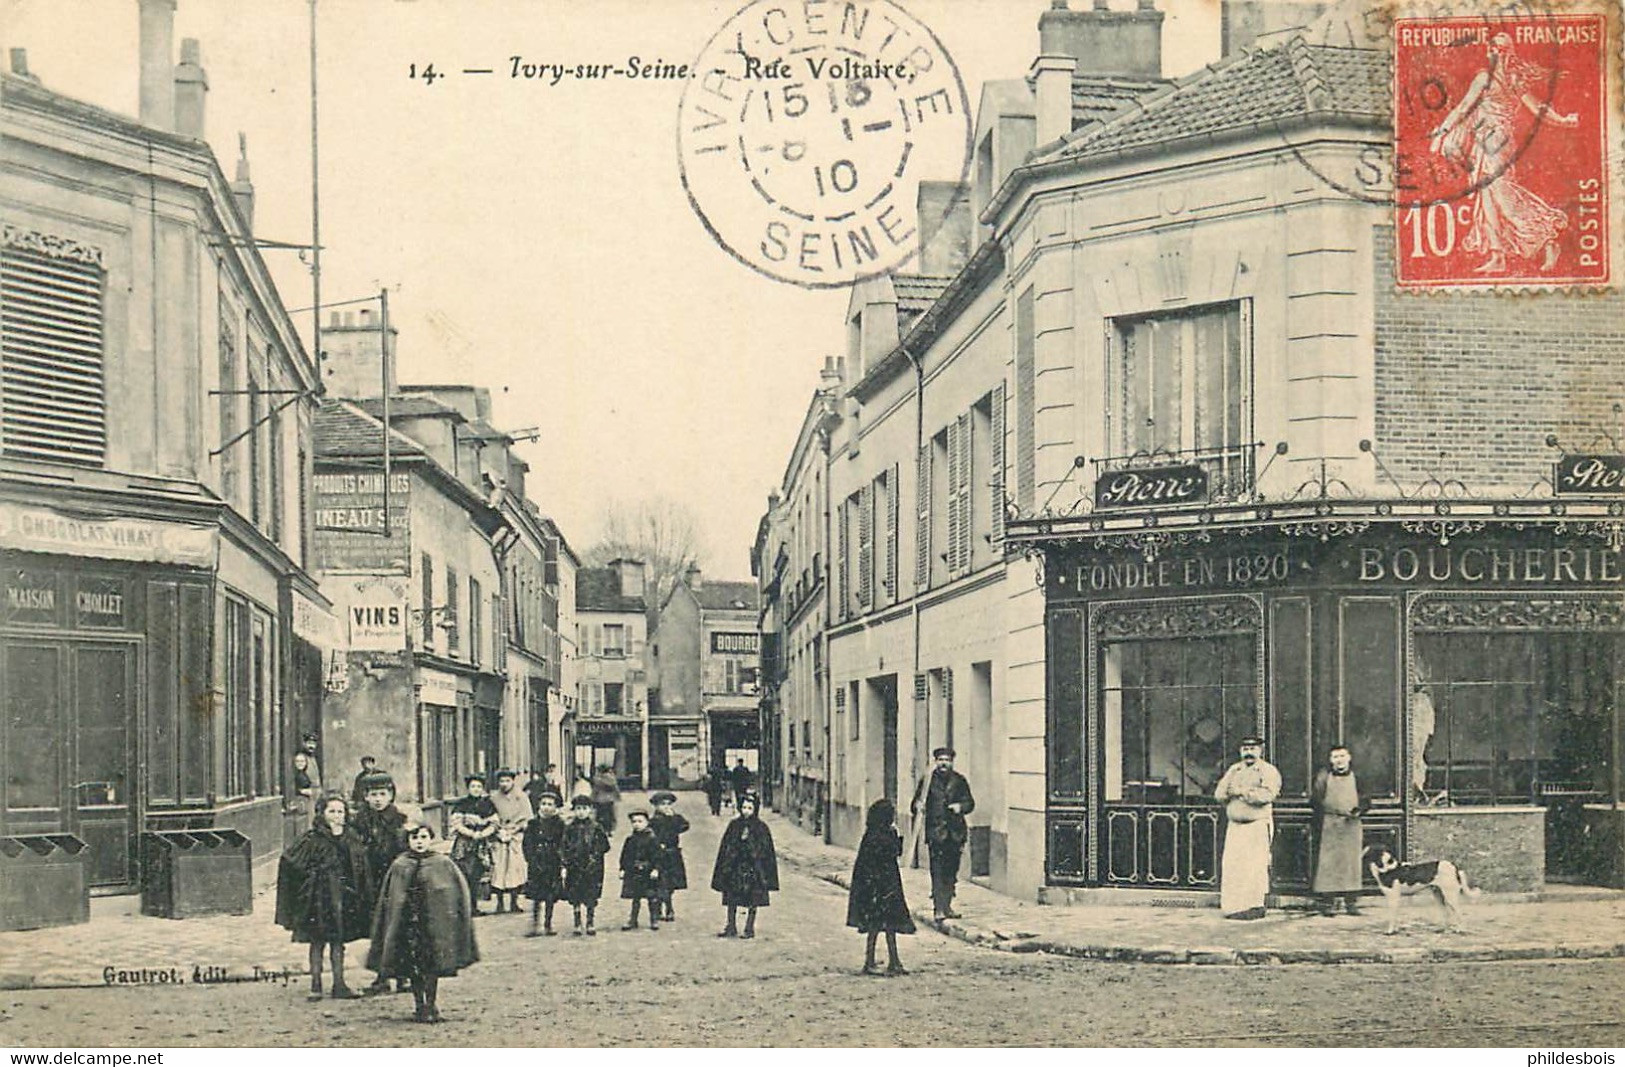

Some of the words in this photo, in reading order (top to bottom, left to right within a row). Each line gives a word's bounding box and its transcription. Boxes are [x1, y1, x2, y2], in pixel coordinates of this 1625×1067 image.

[814, 158, 858, 198] 10
[1578, 177, 1600, 267] POSTES
[761, 205, 917, 273] SEINE
[313, 475, 355, 494] PRODUITS
[1101, 473, 1196, 503] Pierre
[1563, 457, 1625, 488] Pie
[1184, 556, 1217, 585] EN
[1226, 553, 1290, 583] 1820
[1358, 547, 1623, 582] BOUCHERIE
[8, 587, 56, 609] MAISON
[76, 590, 122, 615] CHOLLET
[353, 606, 400, 626] VINS
